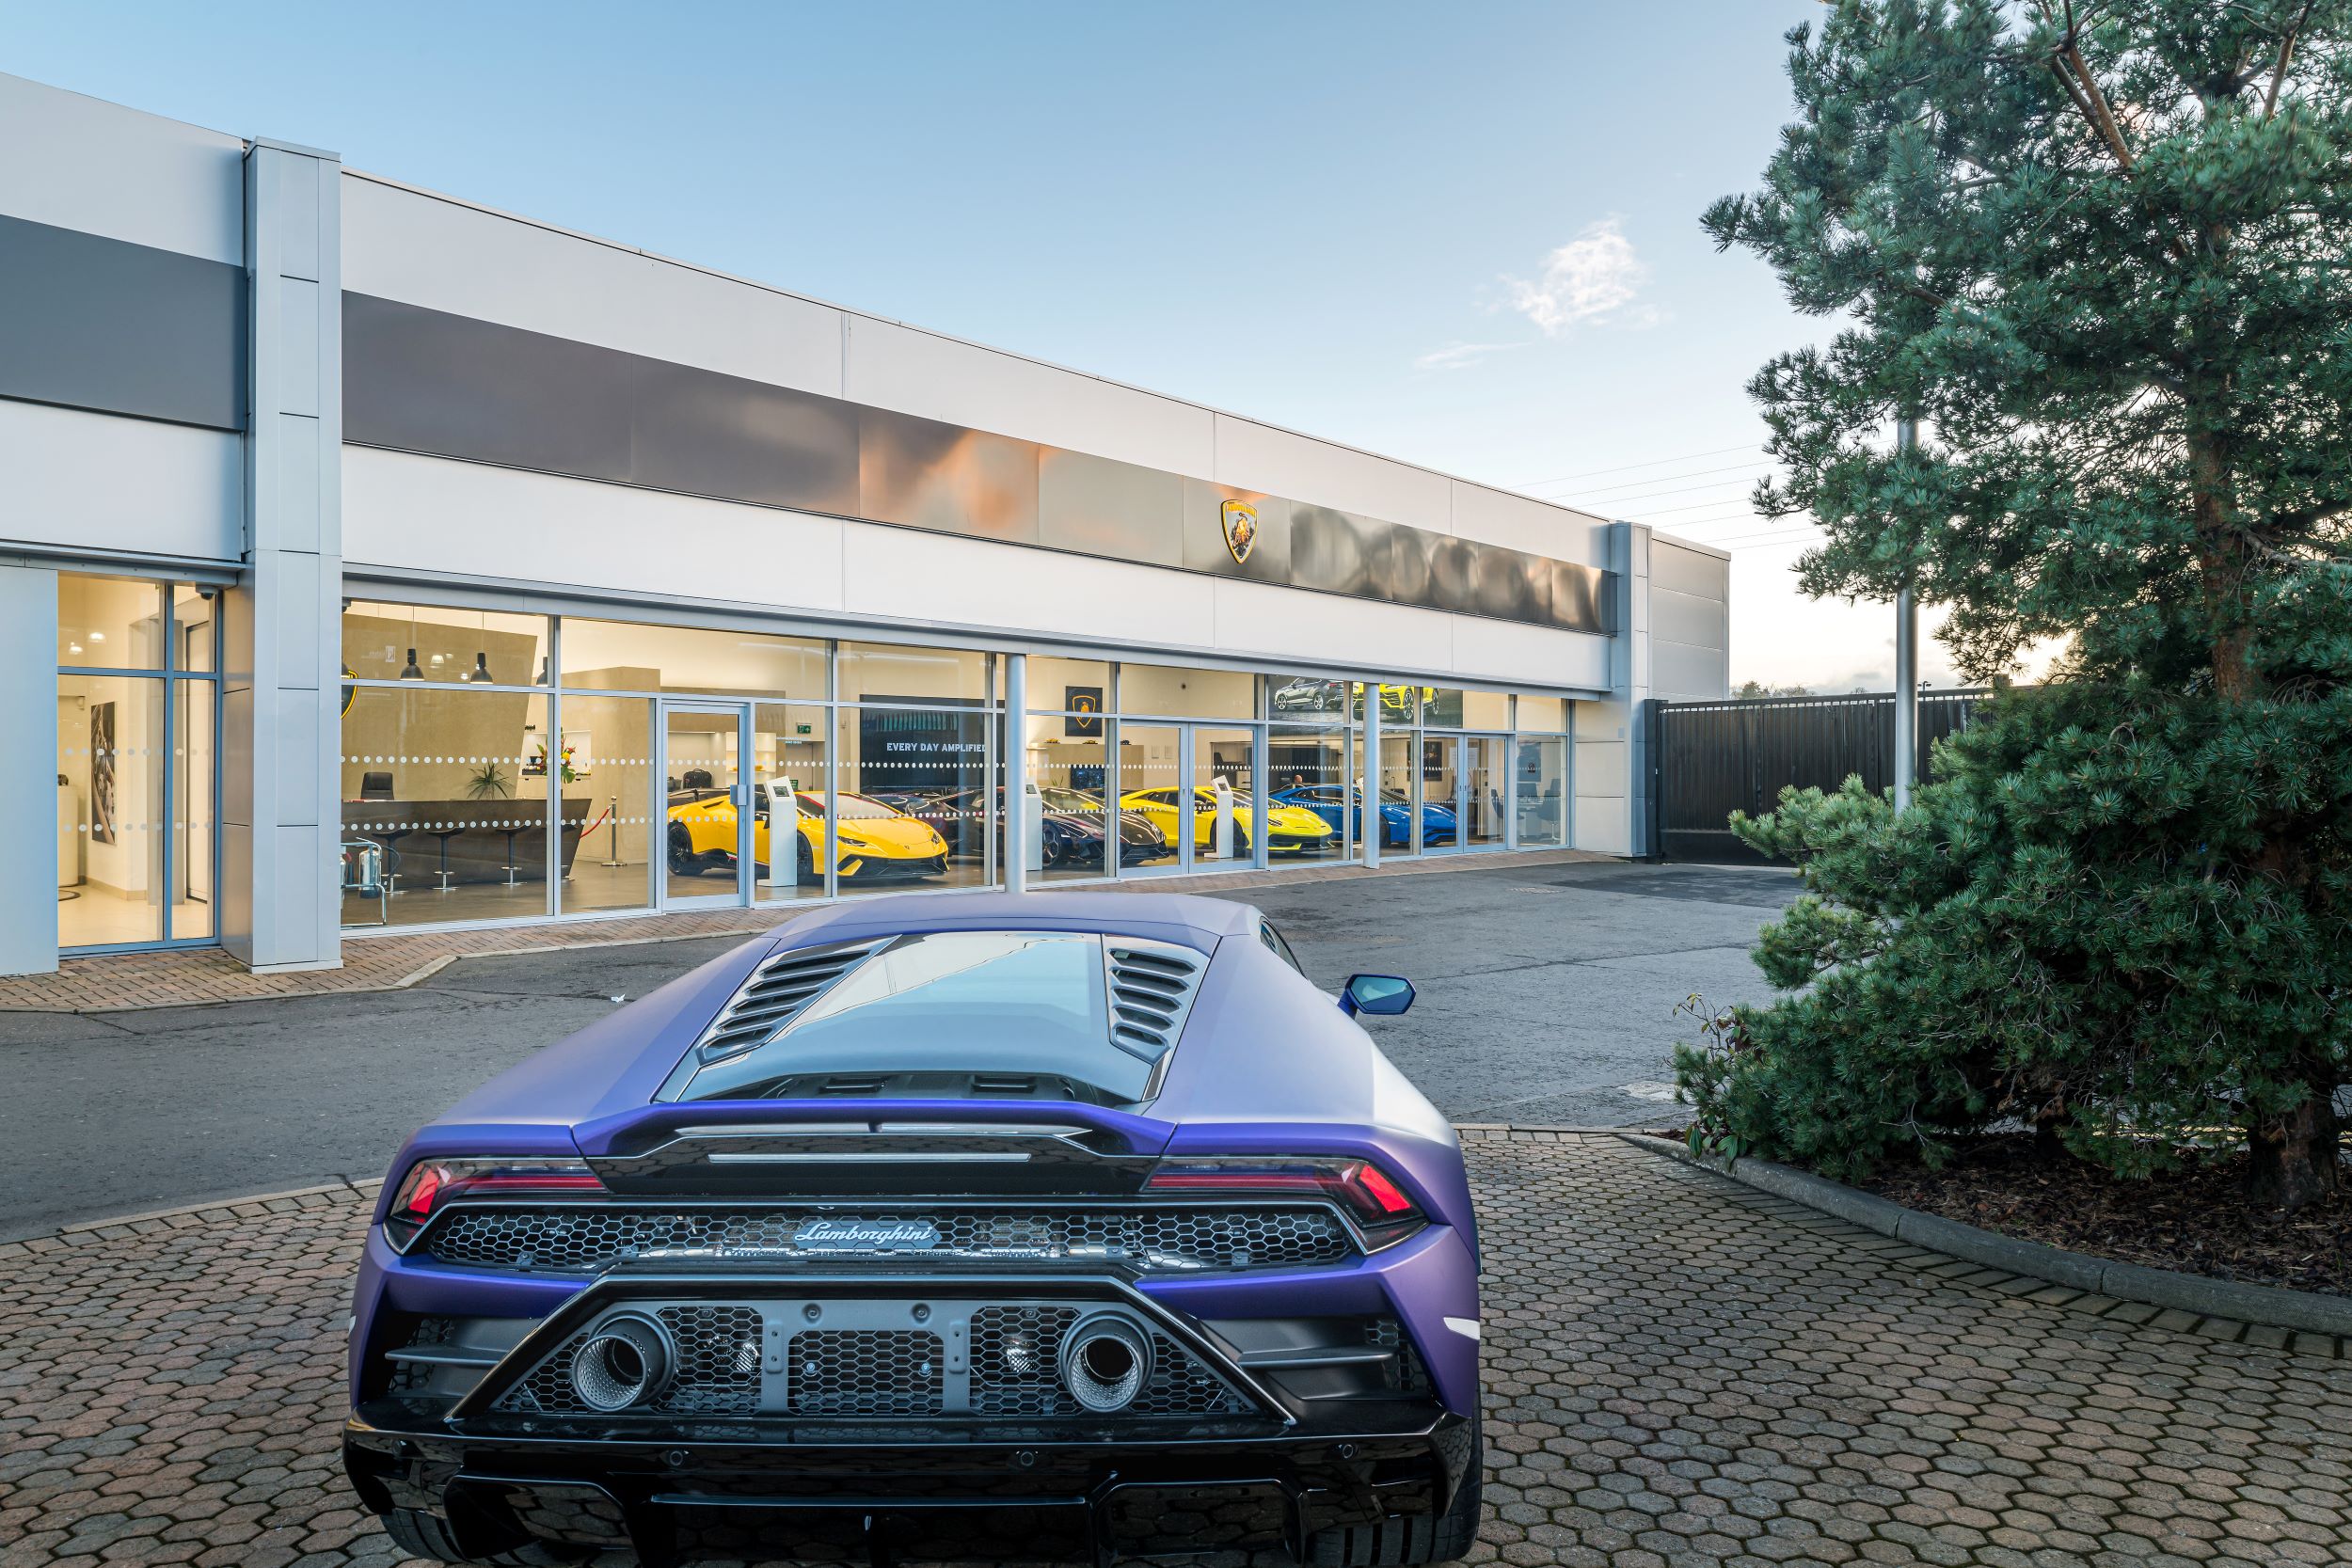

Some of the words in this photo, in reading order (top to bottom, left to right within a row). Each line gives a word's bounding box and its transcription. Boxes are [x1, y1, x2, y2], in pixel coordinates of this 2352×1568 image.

[886, 742, 917, 752] EVERY
[920, 743, 939, 752] DAY
[794, 1222, 933, 1244] Lamborghini
